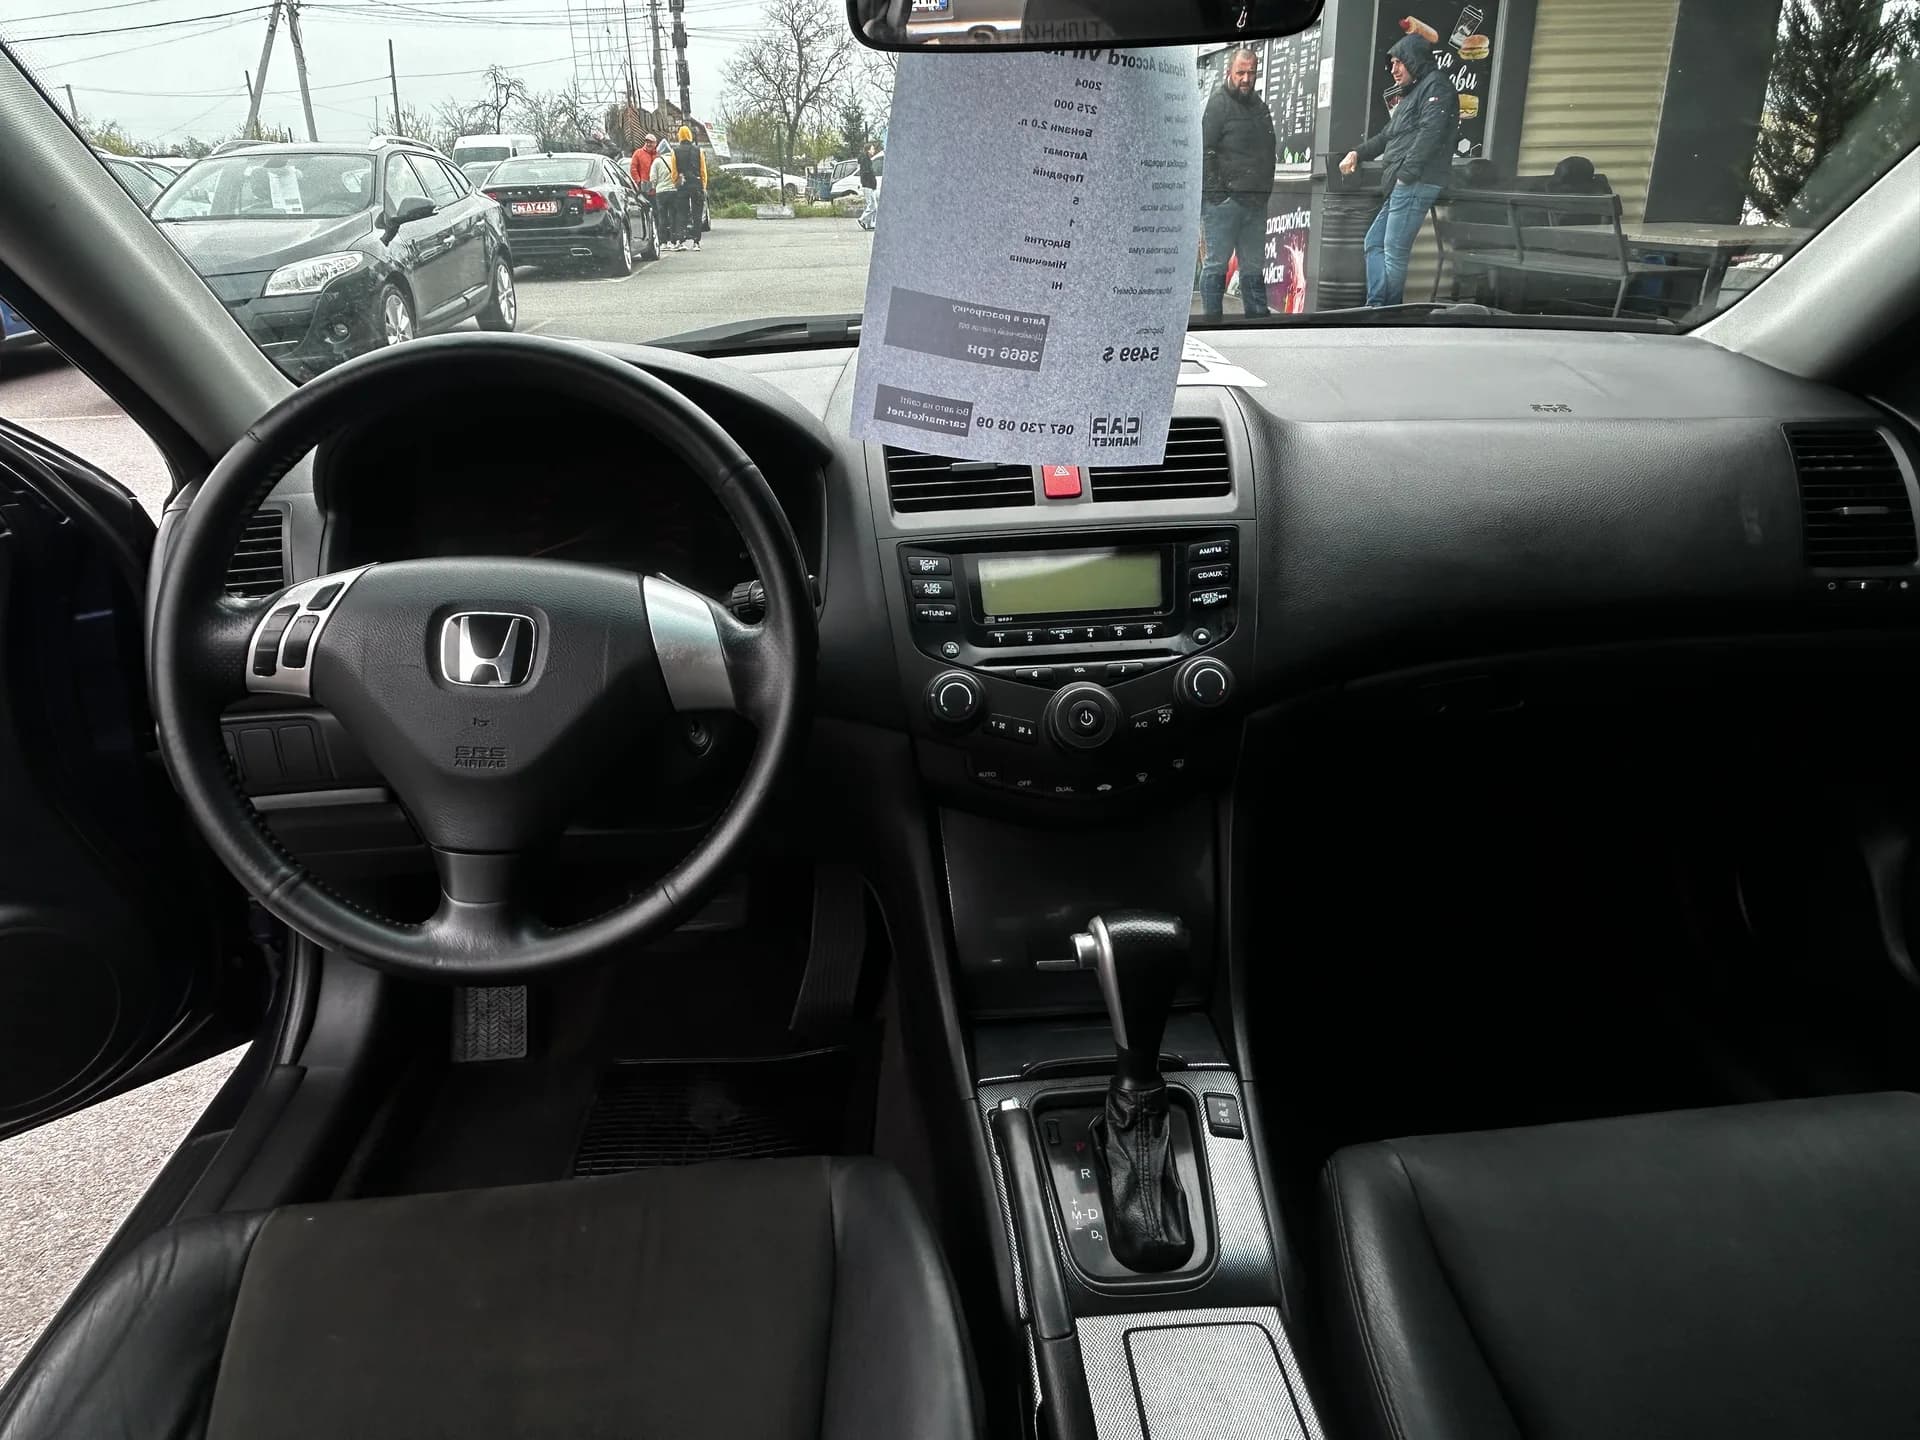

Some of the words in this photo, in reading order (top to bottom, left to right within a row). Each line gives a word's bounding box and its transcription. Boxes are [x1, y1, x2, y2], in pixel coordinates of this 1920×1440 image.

[1199, 546, 1223, 555] AM/FM
[1197, 570, 1223, 579] CD/AUX
[1055, 785, 1075, 793] DUAL
[1080, 1168, 1091, 1180] R
